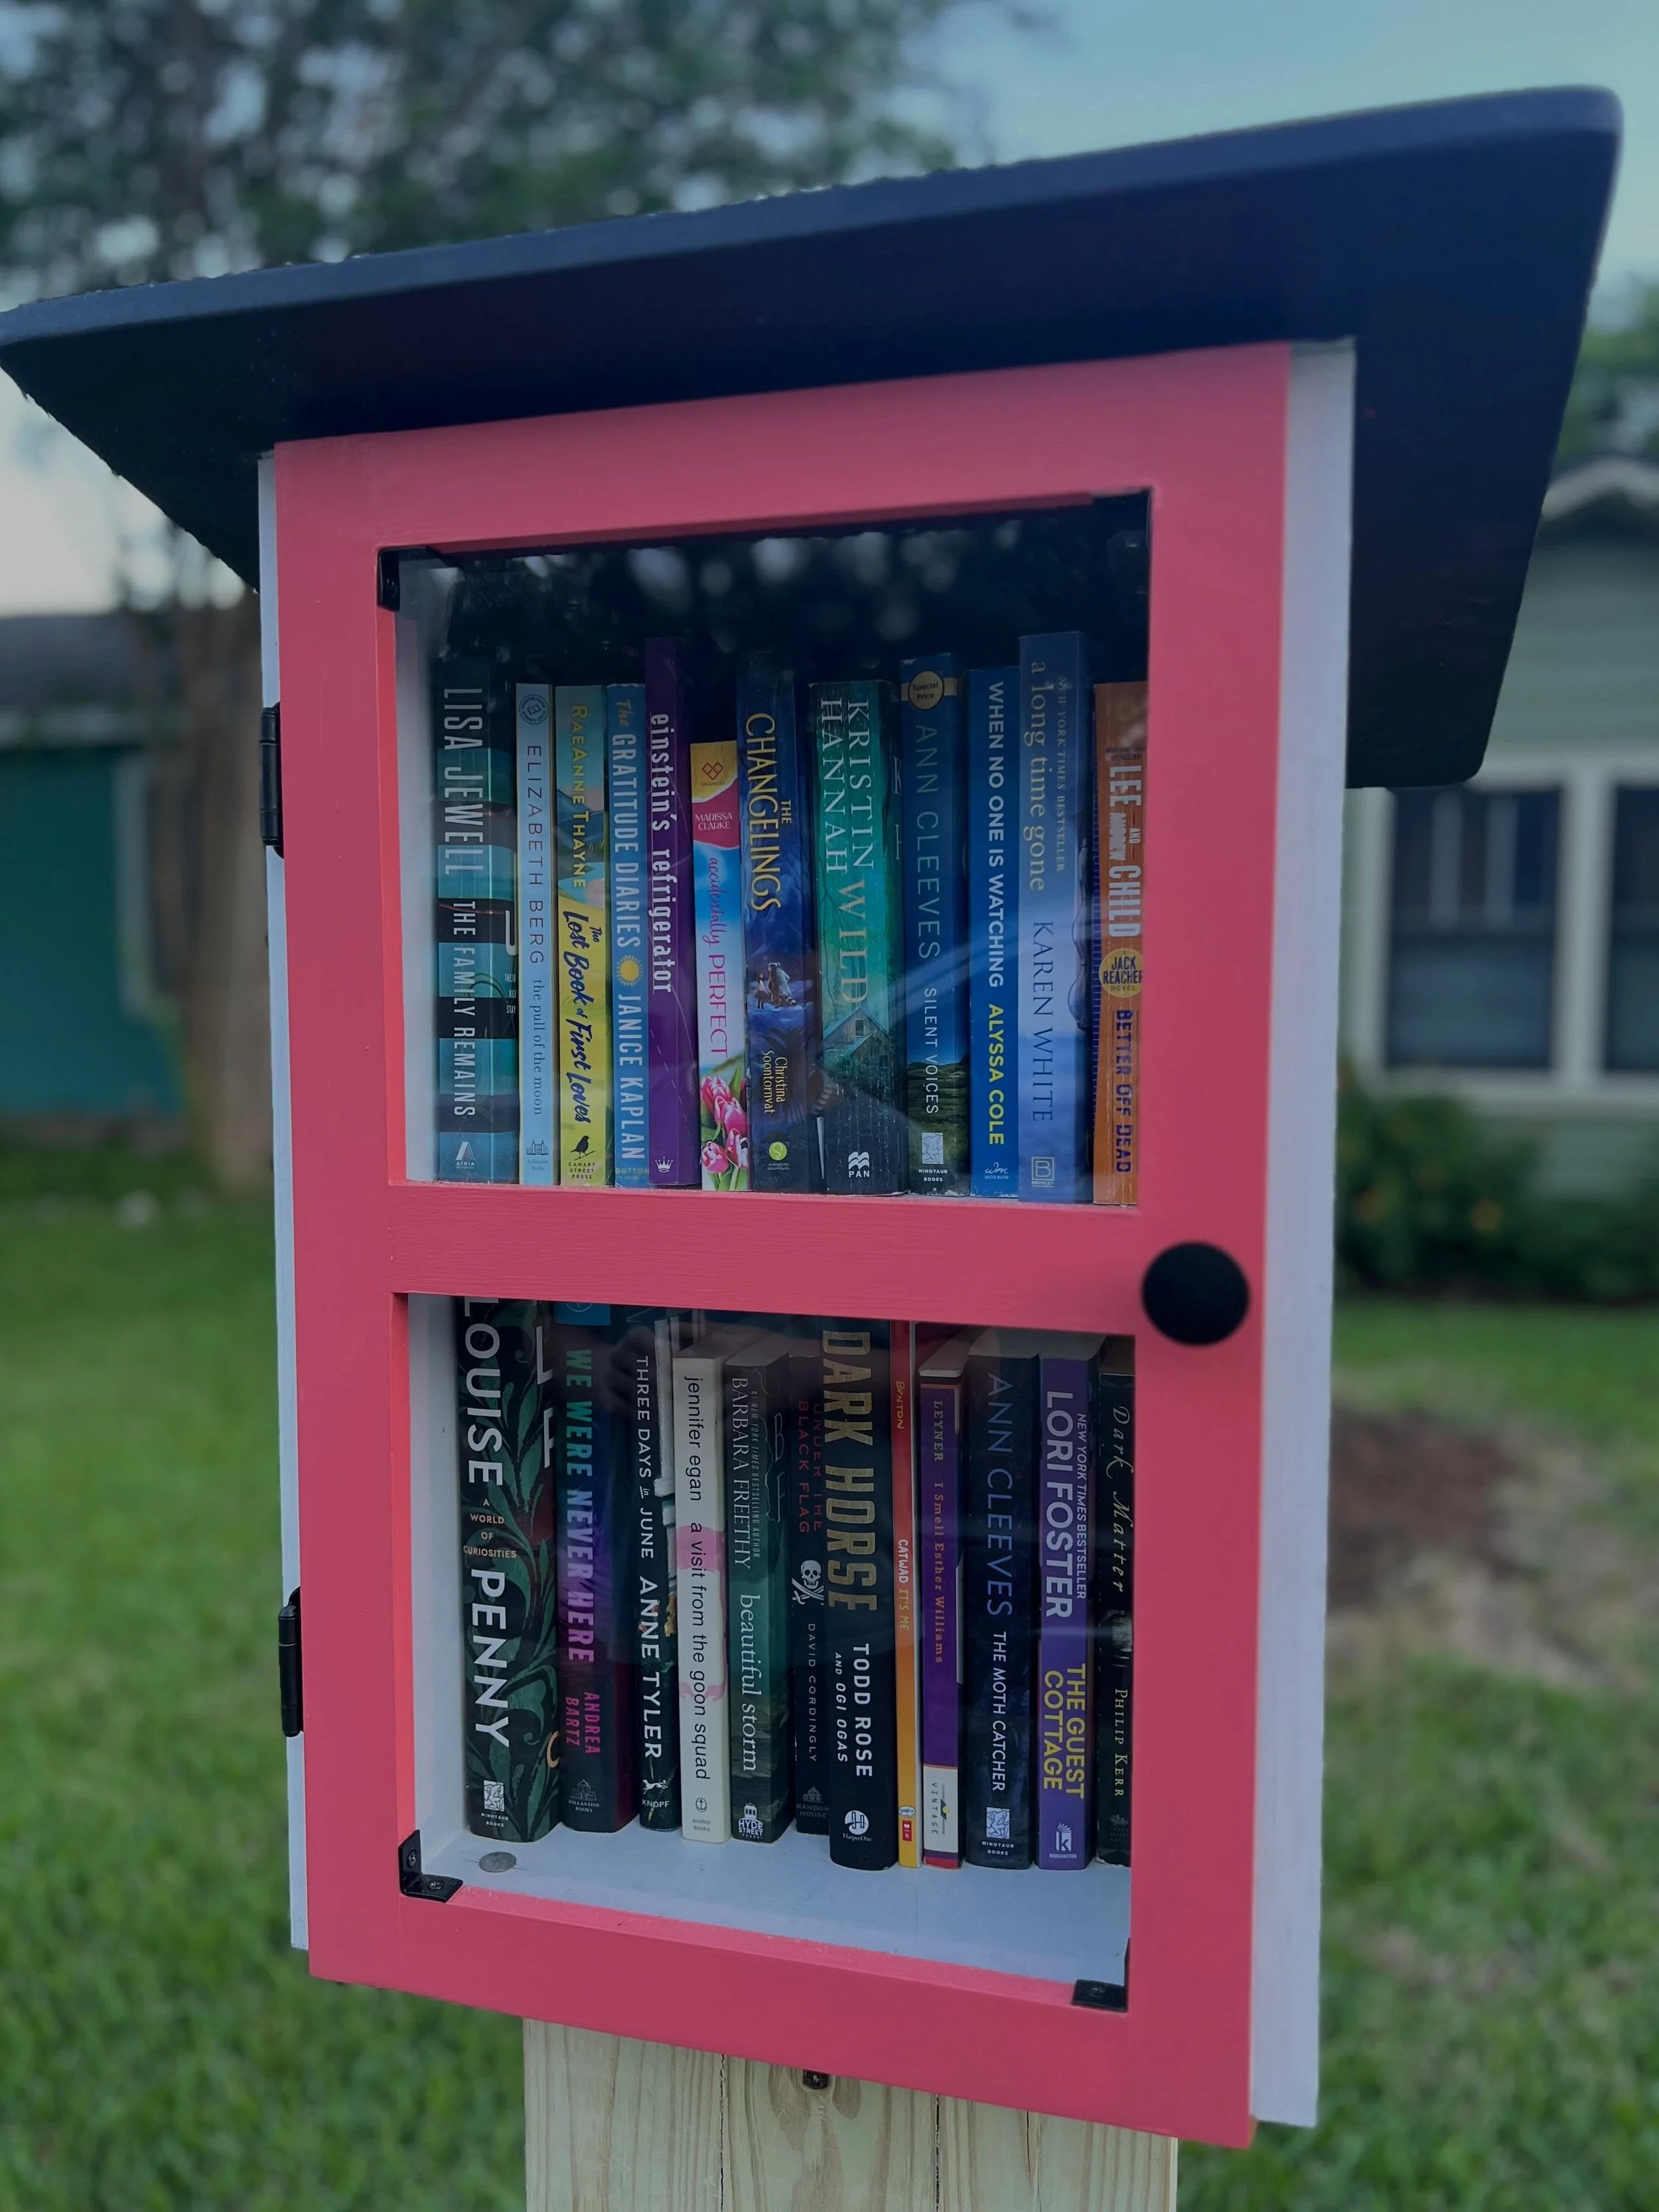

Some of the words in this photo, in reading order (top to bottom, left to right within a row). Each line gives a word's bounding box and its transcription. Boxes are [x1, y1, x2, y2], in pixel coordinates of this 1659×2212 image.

[912, 682, 938, 692] Special
[1031, 662, 1045, 674] a
[1058, 678, 1066, 707] NEW
[443, 688, 482, 751] LISA
[616, 699, 632, 726] The
[989, 681, 1004, 749] WHEN
[1024, 682, 1054, 747] long
[1057, 711, 1066, 746] YORK
[650, 713, 677, 831] einstein's
[820, 698, 847, 874] HANNAH
[847, 700, 874, 869] KRISTIN
[916, 725, 938, 794] ANN
[988, 757, 1004, 788] NO
[1031, 757, 1052, 818] time
[1056, 751, 1066, 790] TIMES
[1110, 765, 1142, 807] LEE
[445, 767, 483, 875] JEWELL
[528, 746, 543, 885] ELIZABETH
[613, 734, 638, 852] GRATITUDE
[695, 812, 733, 822] MARISSA
[746, 713, 781, 911] CHANGELINGS
[780, 799, 791, 823] THE
[989, 796, 1004, 841] ONE
[698, 821, 730, 831] CLARKE
[1056, 796, 1065, 873] BESTSELLER
[1129, 828, 1141, 844] AND
[916, 811, 940, 958] CLEEVES
[989, 849, 1004, 867] IS
[1024, 826, 1045, 891] gone
[453, 901, 476, 935] THE
[563, 911, 590, 948] Lost
[614, 863, 642, 948] DIARIES
[648, 849, 678, 994] refrigerator
[702, 857, 727, 945] accidentally
[988, 873, 1004, 988] WATCHING
[1108, 865, 1141, 937] CHILD
[529, 901, 544, 964] BERG
[590, 926, 603, 942] The
[837, 879, 869, 1003] WILD
[453, 946, 476, 1016] FAMILY
[533, 980, 543, 1001] the
[563, 951, 594, 1004] Book
[1033, 921, 1053, 1015] KAREN
[1112, 956, 1136, 970] JACK
[530, 1005, 545, 1030] pull
[576, 1009, 587, 1018] of
[618, 994, 643, 1066] JANICE
[709, 954, 727, 1058] PERFECT
[924, 988, 937, 1047] SILENT
[453, 1027, 476, 1116] REMAINS
[534, 1036, 544, 1048] of
[534, 1052, 544, 1072] the
[566, 1019, 592, 1070] First
[989, 1003, 1003, 1082] ALYSSA
[1116, 1010, 1133, 1074] BETTER
[534, 1078, 543, 1115] moon
[566, 1072, 591, 1123] Loves
[762, 1051, 775, 1114] Soontornvat
[774, 1057, 788, 1102] Christina
[925, 1055, 938, 1114] VOICES
[1033, 1027, 1052, 1121] WHITE
[1116, 1084, 1133, 1115] OFF
[620, 1077, 645, 1159] KAPLAN
[989, 1090, 1004, 1145] COLE
[1116, 1124, 1132, 1173] DEAD
[464, 1297, 502, 1485] LOUISE
[566, 1349, 591, 1388] WE
[636, 1356, 650, 1421] THREE
[822, 1330, 873, 1446] DARK
[566, 1401, 593, 1475] WERE
[685, 1376, 704, 1447] jennifer
[731, 1378, 749, 1469] BARBARA
[798, 1400, 809, 1471] BLACK
[933, 1400, 944, 1461] LEYNER
[987, 1373, 1013, 1452] ANN
[1046, 1391, 1074, 1471] LORI
[1076, 1413, 1087, 1442] NEW
[638, 1428, 651, 1478] DAYS
[1076, 1446, 1087, 1480] YORK
[1106, 1406, 1134, 1478] Dark
[640, 1487, 652, 1499] in
[685, 1455, 702, 1501] egan
[798, 1482, 810, 1533] FLAG
[1076, 1484, 1086, 1521] TIMES
[470, 1513, 504, 1524] WORLD
[481, 1532, 494, 1540] OF
[567, 1489, 593, 1580] NEVER
[640, 1507, 654, 1558] JUNE
[691, 1522, 703, 1533] a
[733, 1479, 751, 1570] FREETHY
[825, 1465, 877, 1611] HORSE
[934, 1494, 944, 1536] Smell
[987, 1468, 1013, 1615] CLEEVES
[1112, 1491, 1133, 1592] Matter
[463, 1545, 517, 1558] CURIOSITIES
[691, 1540, 707, 1578] visit
[897, 1539, 908, 1584] CATWAD
[935, 1542, 944, 1590] Esther
[1045, 1482, 1073, 1618] FOSTER
[1076, 1524, 1086, 1599] BESTSELLER
[568, 1591, 594, 1662] HERE
[640, 1576, 660, 1659] ANNE
[692, 1585, 707, 1626] from
[899, 1588, 910, 1611] IT'S
[900, 1615, 909, 1633] ME.
[471, 1569, 510, 1748] PENNY
[693, 1635, 707, 1662] the
[739, 1593, 762, 1696] beautiful
[808, 1623, 816, 1667] DAVID
[935, 1596, 944, 1663] Williams
[993, 1631, 1007, 1661] THE
[689, 1670, 708, 1716] goon
[835, 1682, 846, 1710] OGI
[853, 1643, 871, 1705] TODD
[992, 1668, 1006, 1714] MOTH
[1066, 1663, 1086, 1710] THE
[565, 1697, 579, 1746] BARTZ
[585, 1692, 601, 1754] ANDREA
[642, 1671, 662, 1758] TYLER
[742, 1703, 760, 1771] storm
[808, 1675, 817, 1763] CORDINGLY
[836, 1719, 848, 1763] OGAS
[1044, 1670, 1063, 1790] COTTAGE
[691, 1724, 710, 1779] squad
[855, 1717, 873, 1777] ROSE
[991, 1720, 1006, 1791] CATCHER
[1066, 1717, 1085, 1799] GUEST
[642, 1799, 670, 1808] KNOPF
[738, 1818, 763, 1830] HYDE
[739, 1828, 762, 1836] STREET
